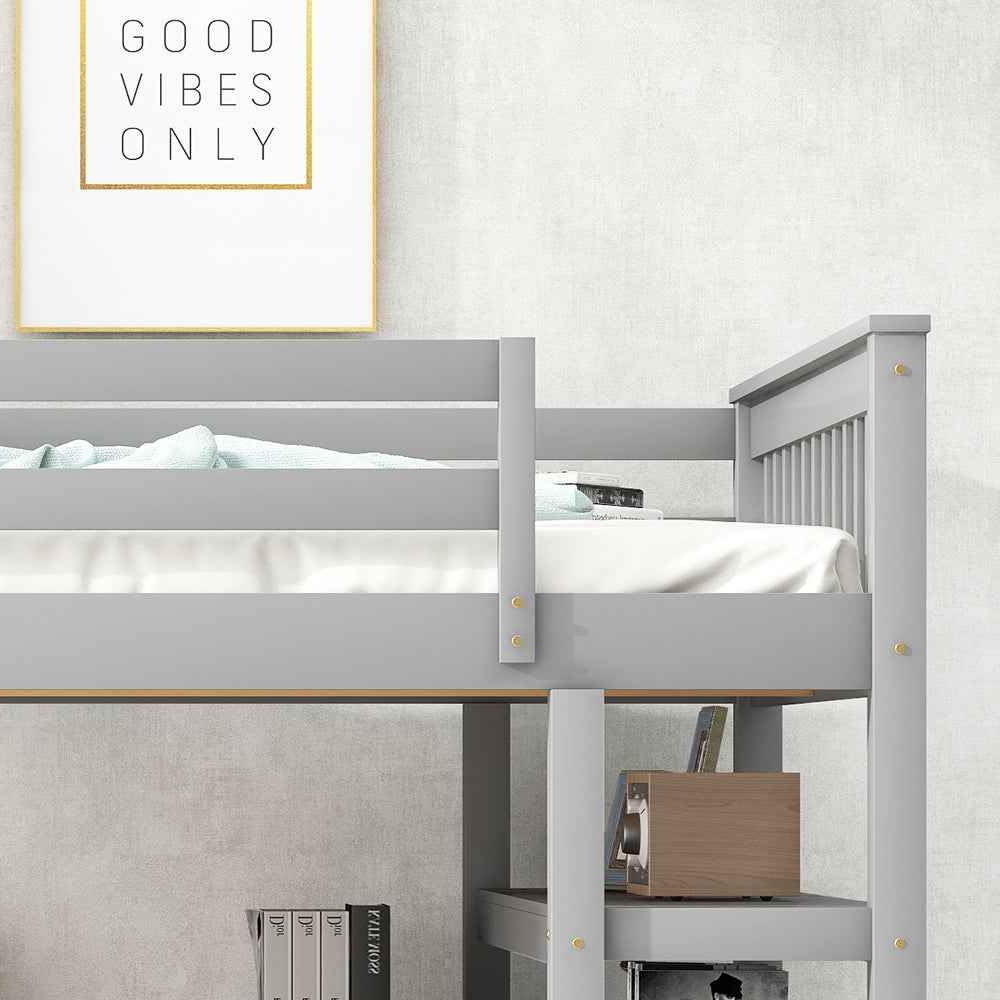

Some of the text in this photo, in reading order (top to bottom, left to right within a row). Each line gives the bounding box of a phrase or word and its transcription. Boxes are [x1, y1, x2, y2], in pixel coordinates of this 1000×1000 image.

[121, 19, 273, 53] GOOD
[119, 72, 272, 107] VIBES
[121, 126, 275, 161] ONLY
